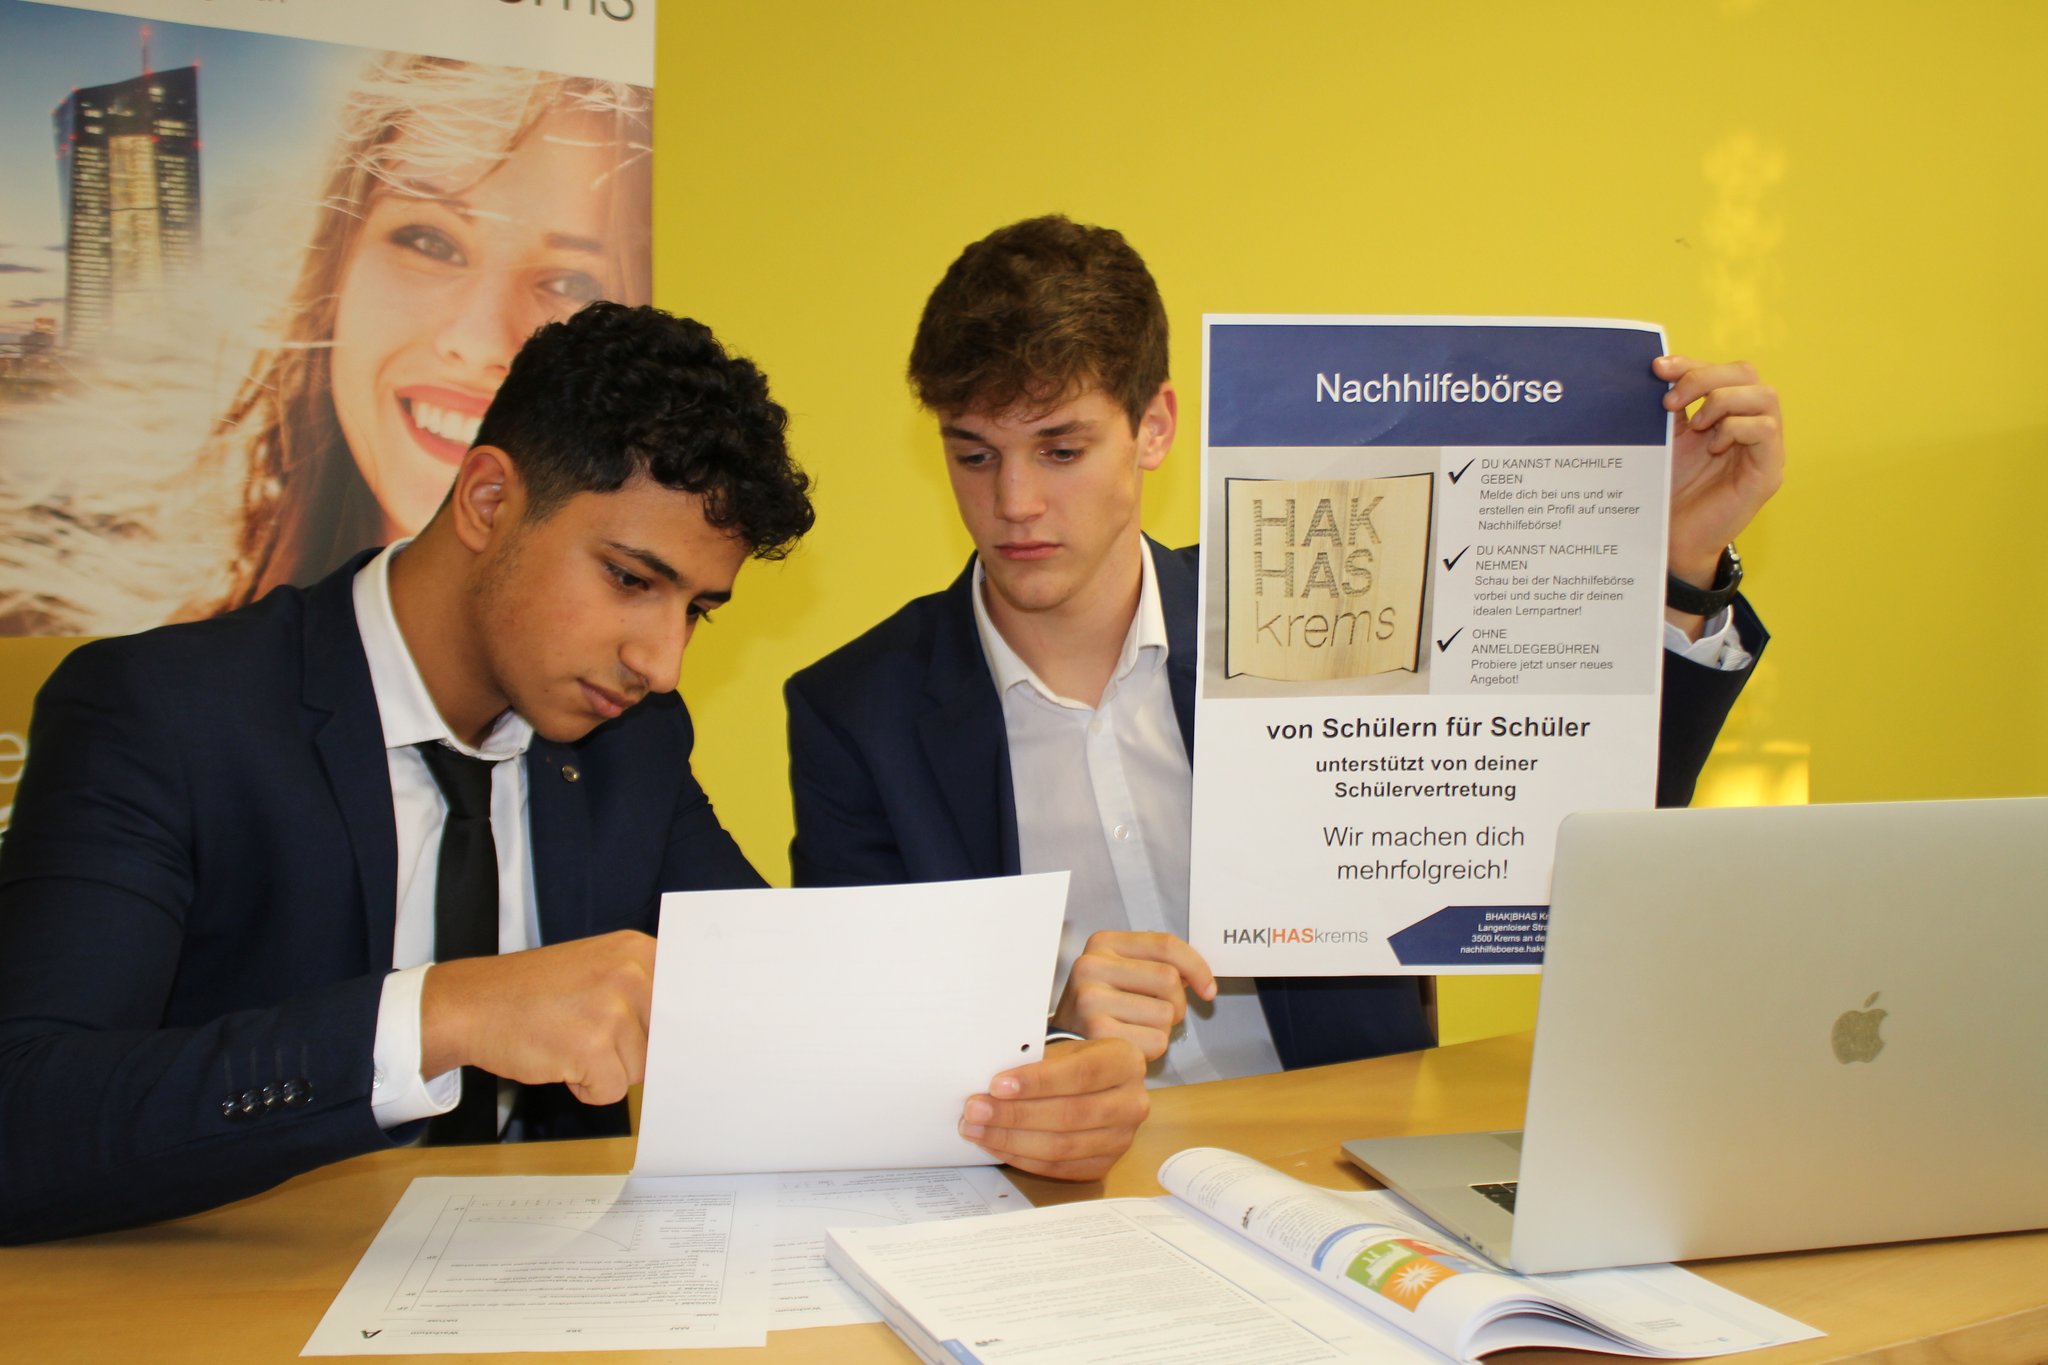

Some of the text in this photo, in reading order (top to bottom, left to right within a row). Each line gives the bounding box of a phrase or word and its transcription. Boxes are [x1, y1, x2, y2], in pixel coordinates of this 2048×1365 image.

[1316, 372, 1563, 403] Nachhilfebörse
[1481, 457, 1623, 470] DU KANNST NACHHILFE
[1480, 473, 1523, 485] GEBEN
[1479, 489, 1624, 500] Melde dich bei uns und wir
[1478, 503, 1641, 516] erstellen ein Profil auf unserer
[1252, 495, 1385, 547] HAK
[1478, 519, 1562, 531] Nachhilfebörse!
[1476, 544, 1619, 556] DU KANNST NACHHILFE
[1475, 559, 1528, 571] NEHMEN
[1252, 547, 1374, 598] HAS
[1474, 575, 1635, 586] Schau bei der Nachhilfebörse
[1473, 590, 1624, 601] vorbei und suche dir deinen
[1472, 605, 1582, 618] idealen Lernpartner!
[1255, 600, 1397, 648] krems
[1472, 628, 1507, 640] OHNE
[1471, 642, 1600, 655] ANMELDEGEBÜHREN
[1470, 658, 1614, 672] Probiere jetzt unser neues
[1470, 674, 1519, 687] Angebot!
[1266, 716, 1591, 740] von Schülern für Schüler
[1316, 754, 1539, 773] unterstützt von deiner
[1334, 781, 1516, 802] Schülervertretung
[1323, 826, 1525, 847] Wir machen dich
[1337, 859, 1508, 885] mehrfolgreich!
[1539, 912, 1549, 921] Kr
[1477, 923, 1530, 933] Langenloiser
[1471, 934, 1493, 943] 3500
[1494, 934, 1521, 943] Krems
[1534, 934, 1546, 942] de
[1459, 944, 1545, 954] nachhilfeboerse.hakk
